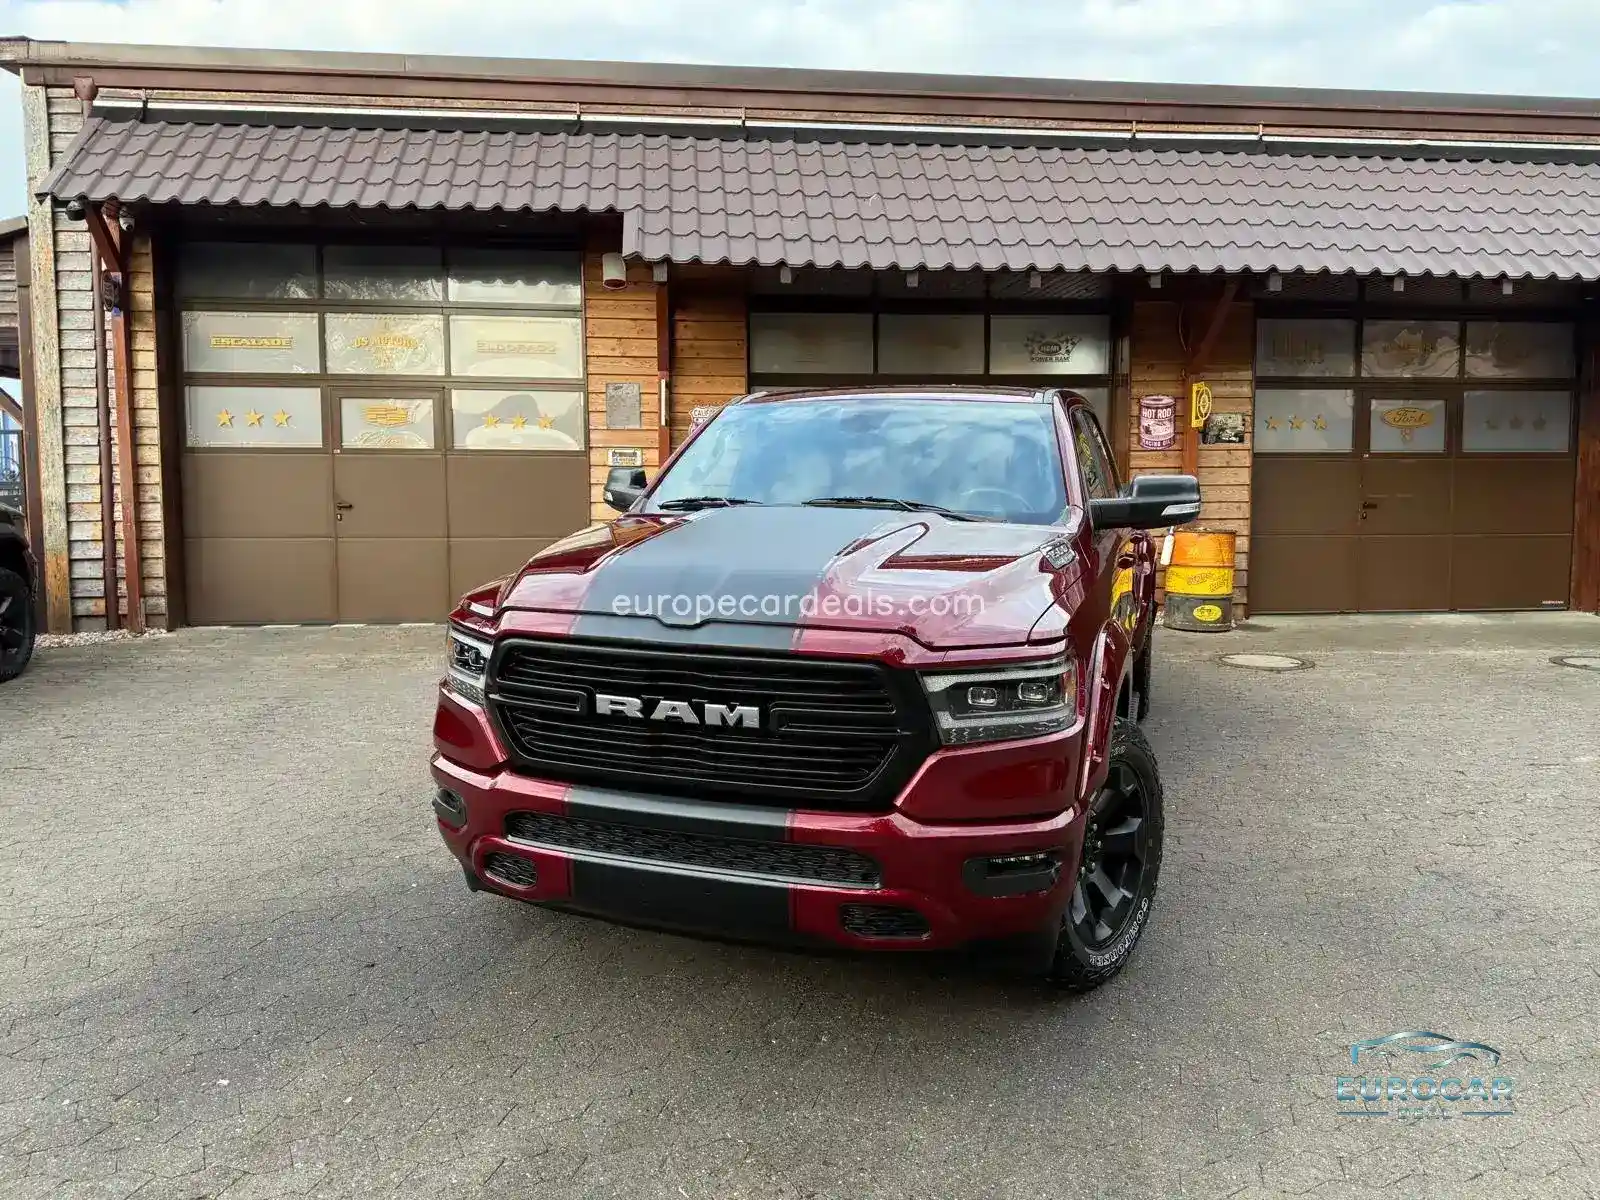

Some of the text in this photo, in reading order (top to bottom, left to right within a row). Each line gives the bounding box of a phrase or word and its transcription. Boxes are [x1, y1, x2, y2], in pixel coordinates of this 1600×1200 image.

[211, 337, 291, 346] ESCALADE
[1142, 408, 1172, 419] HOT ROD
[1393, 408, 1424, 423] Ford
[595, 693, 760, 729] RAM
